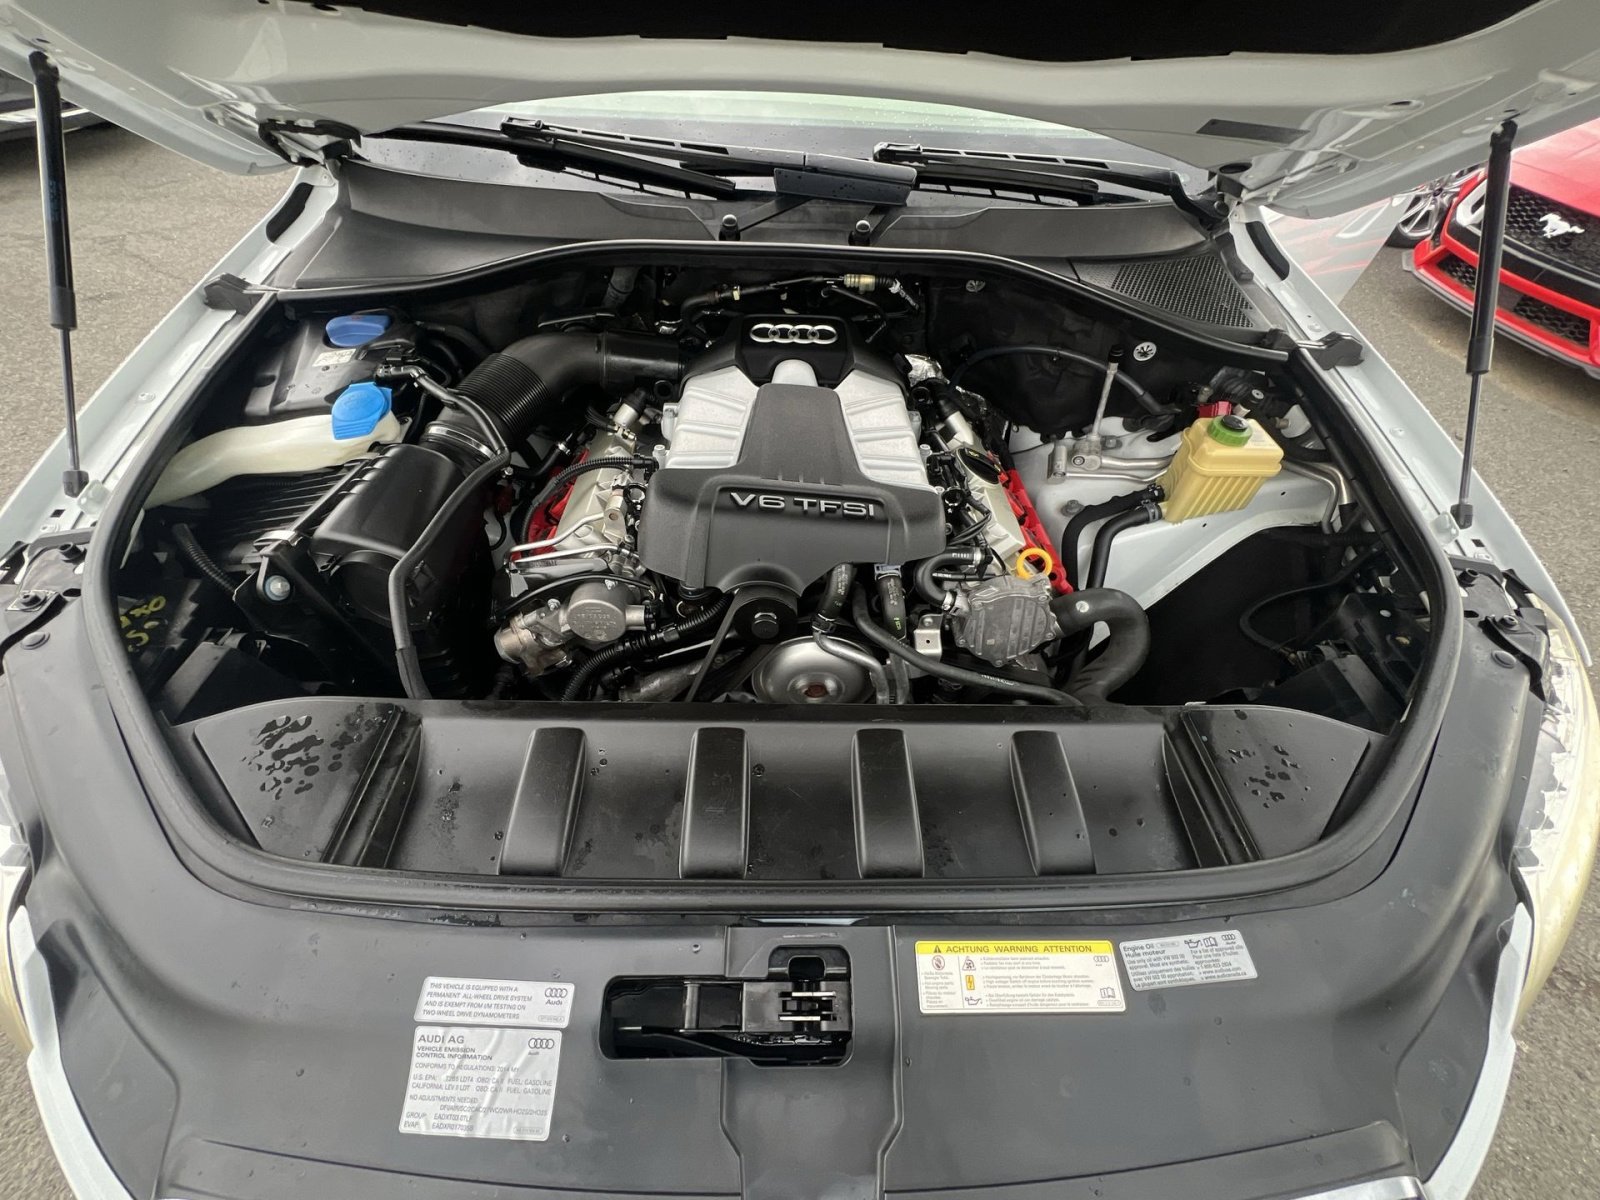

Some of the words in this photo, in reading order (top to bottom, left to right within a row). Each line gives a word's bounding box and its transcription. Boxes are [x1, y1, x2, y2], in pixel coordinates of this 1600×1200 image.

[730, 492, 786, 509] V6
[793, 497, 875, 517] TFSI
[945, 945, 989, 953] ACHTUNG
[993, 945, 1039, 953] WARNING
[1043, 945, 1092, 953] ATTENTION
[472, 984, 498, 992] EQUIPPED
[473, 1012, 520, 1020] DYNAMOMETERS
[418, 1034, 445, 1044] AUDI
[447, 1035, 464, 1044] AG
[523, 1088, 552, 1096] GASOLINE
[418, 1094, 456, 1102] ADJUSTMENTS
